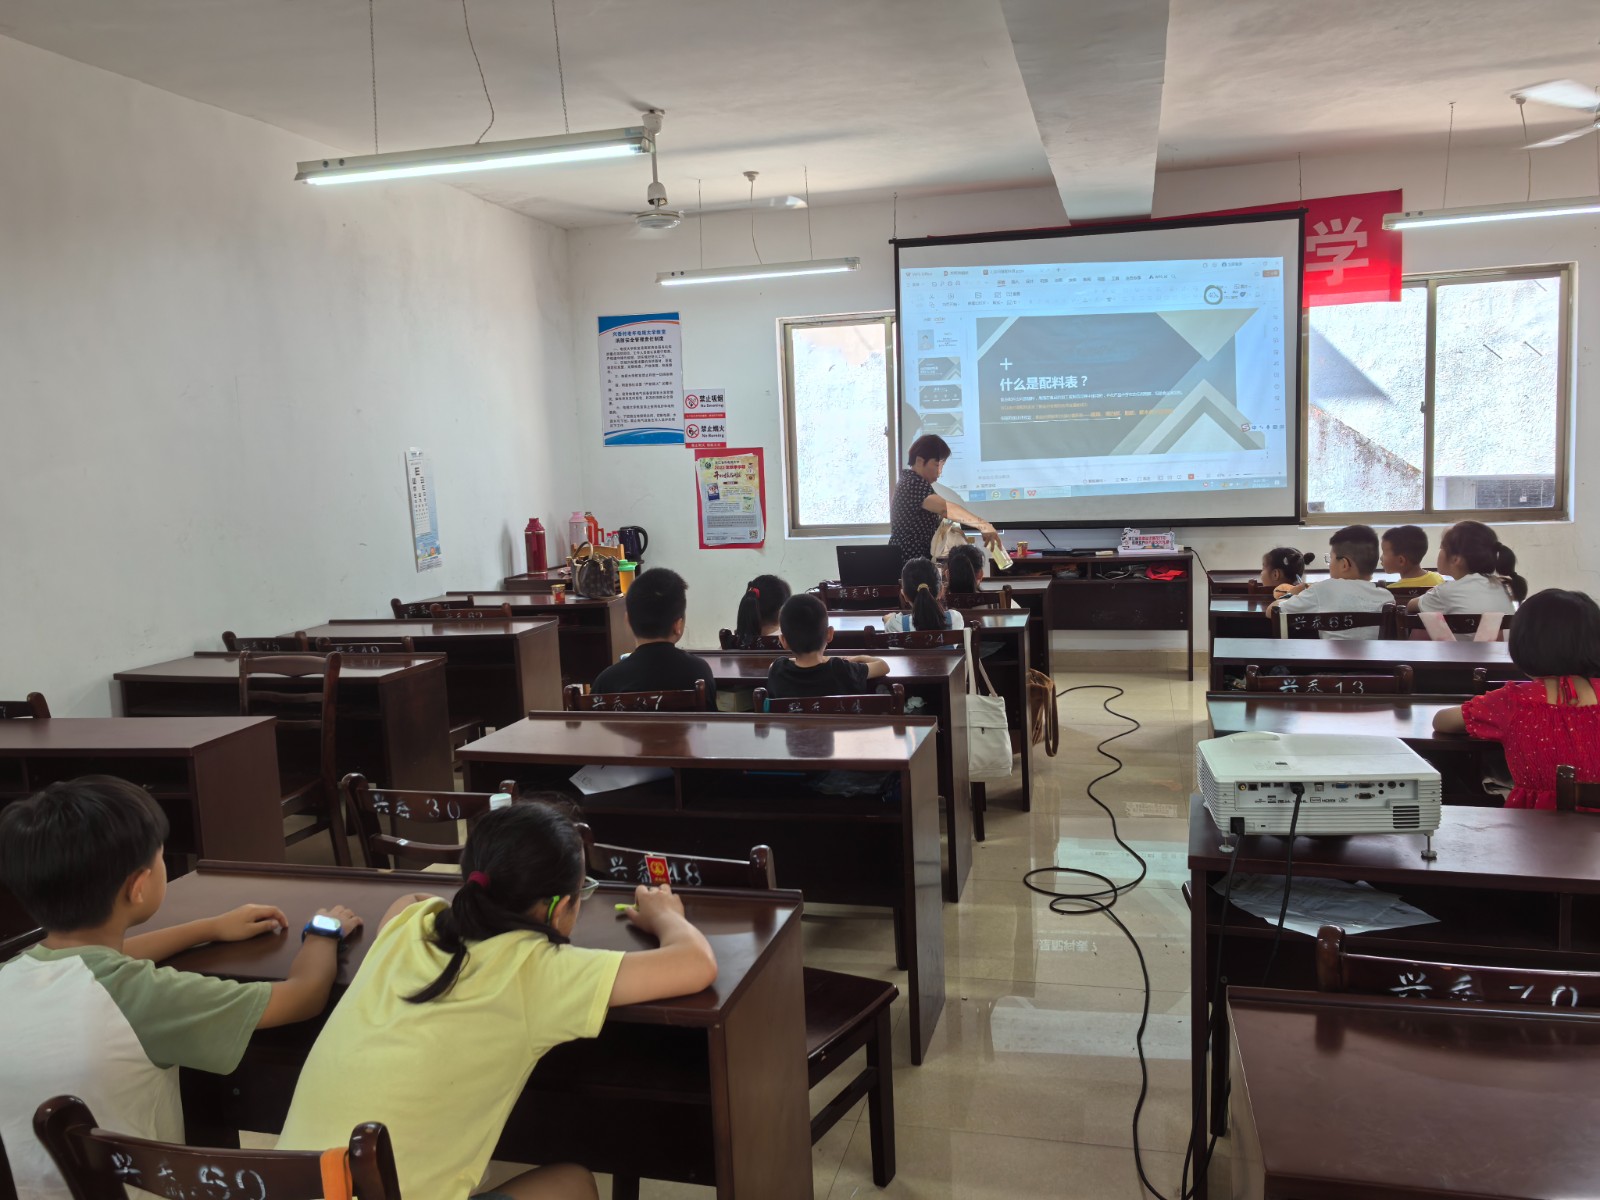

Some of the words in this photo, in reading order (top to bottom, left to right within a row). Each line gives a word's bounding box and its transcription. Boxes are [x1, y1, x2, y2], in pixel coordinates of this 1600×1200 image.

[1305, 216, 1369, 286] 学
[1000, 375, 1088, 391] 什么是配料表？
[699, 394, 724, 403] 禁止吸烟
[1328, 615, 1354, 629] 65
[1335, 680, 1364, 694] 13
[426, 798, 460, 819] 30
